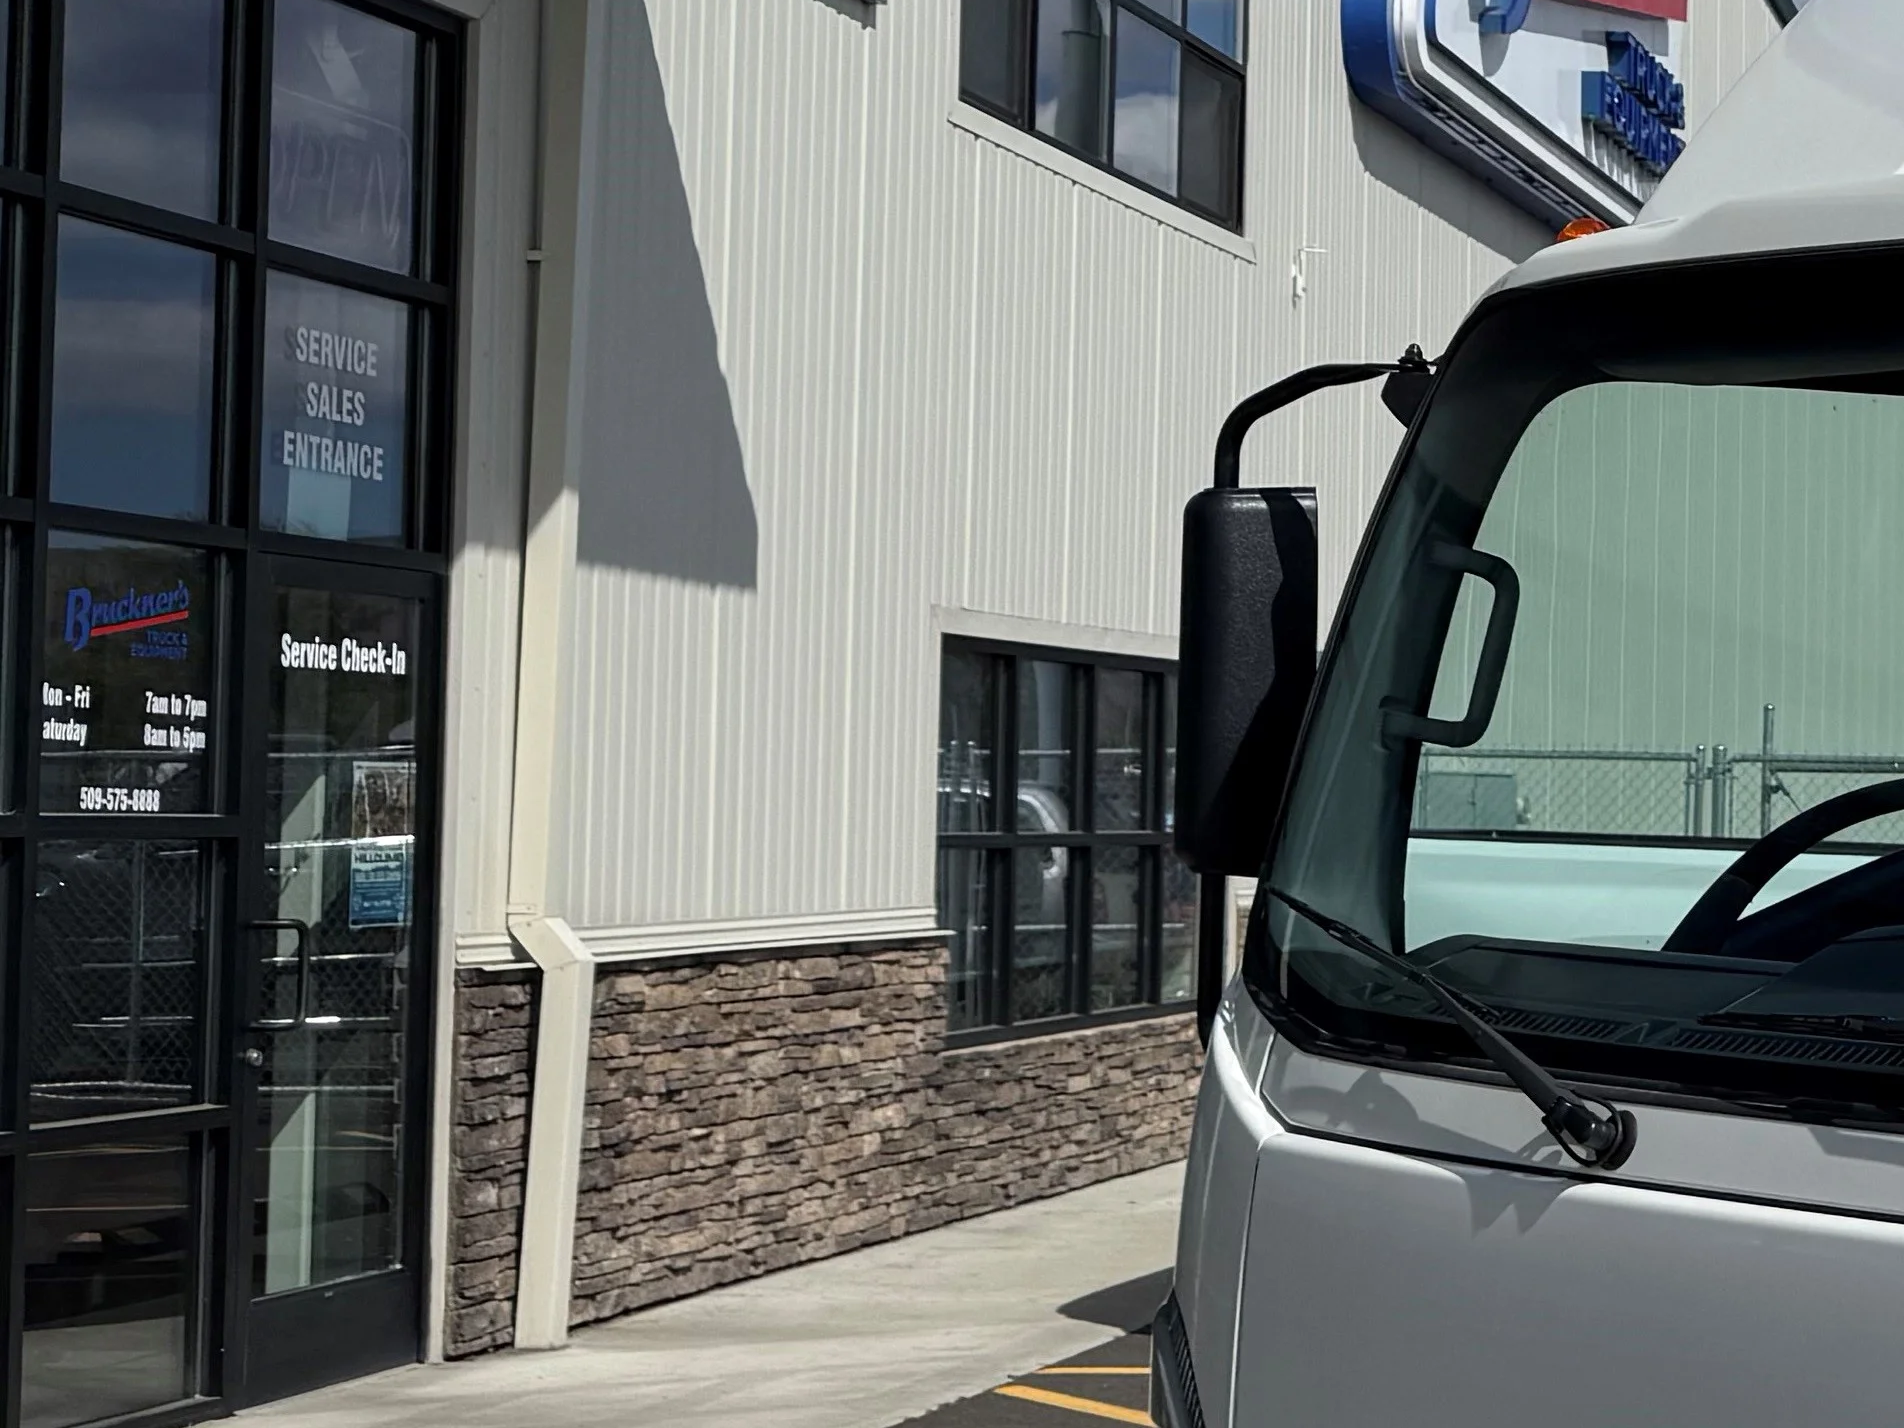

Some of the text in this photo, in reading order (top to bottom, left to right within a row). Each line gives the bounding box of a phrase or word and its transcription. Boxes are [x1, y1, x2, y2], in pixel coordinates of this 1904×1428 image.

[296, 326, 378, 376] SERVICE
[306, 381, 365, 426] SALES
[283, 430, 384, 481] ENTRANCE
[63, 579, 190, 652] Bruckner's
[280, 632, 406, 675] Service Check-In
[74, 684, 91, 709] Fri
[145, 690, 169, 715] 7am
[171, 693, 182, 716] to
[184, 694, 207, 721] 7pm
[42, 717, 88, 747] aturday
[144, 723, 168, 746] 8am
[170, 725, 181, 748] to
